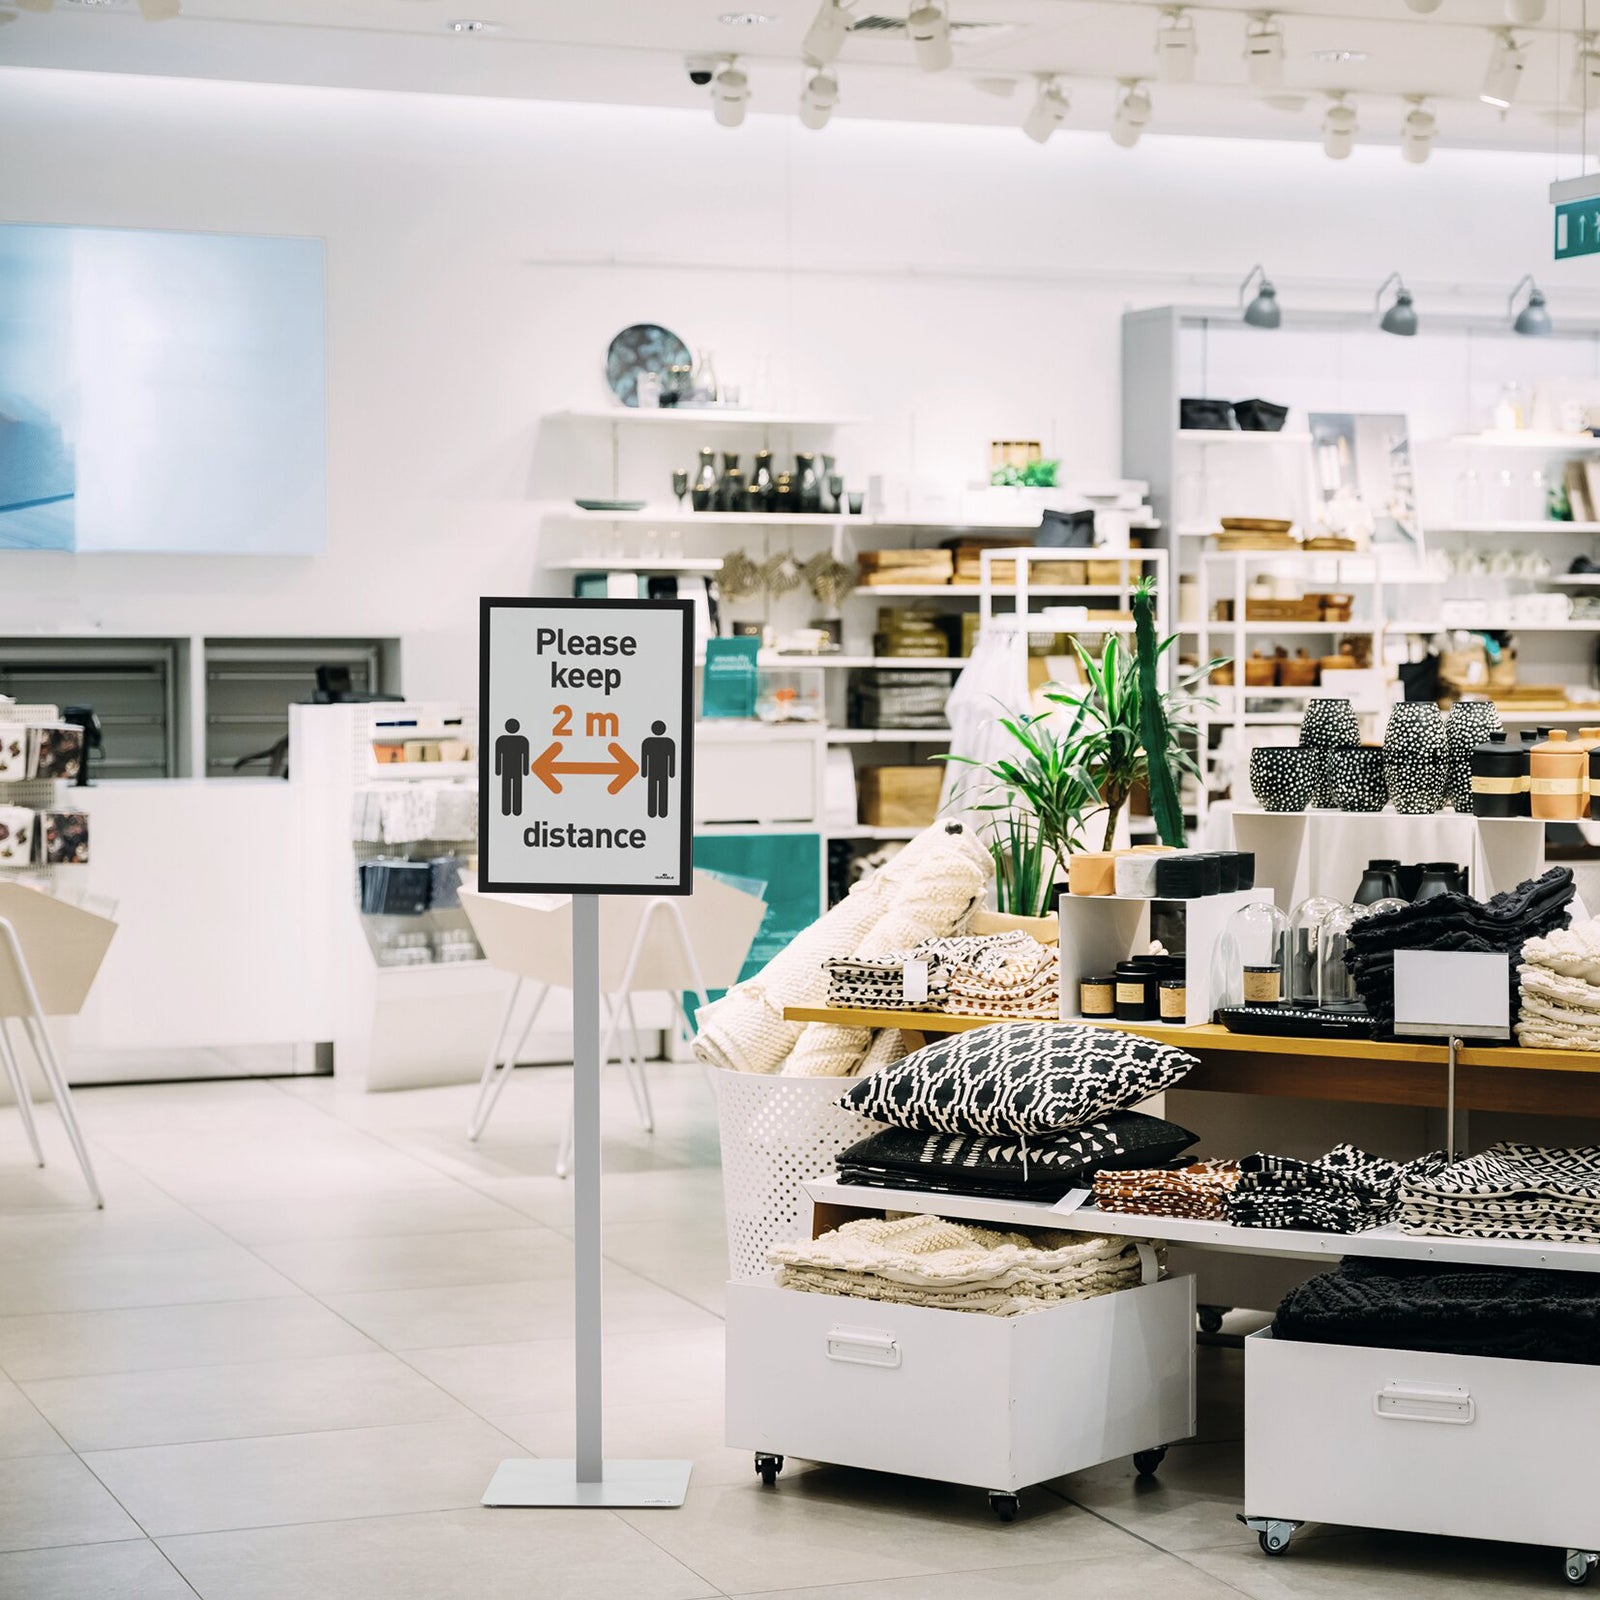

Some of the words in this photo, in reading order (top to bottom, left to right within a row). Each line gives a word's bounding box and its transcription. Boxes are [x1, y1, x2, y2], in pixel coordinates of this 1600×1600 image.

[537, 628, 637, 656] Please
[551, 661, 621, 695] keep
[552, 704, 573, 737] 2
[586, 711, 619, 737] m
[524, 821, 646, 849] distance
